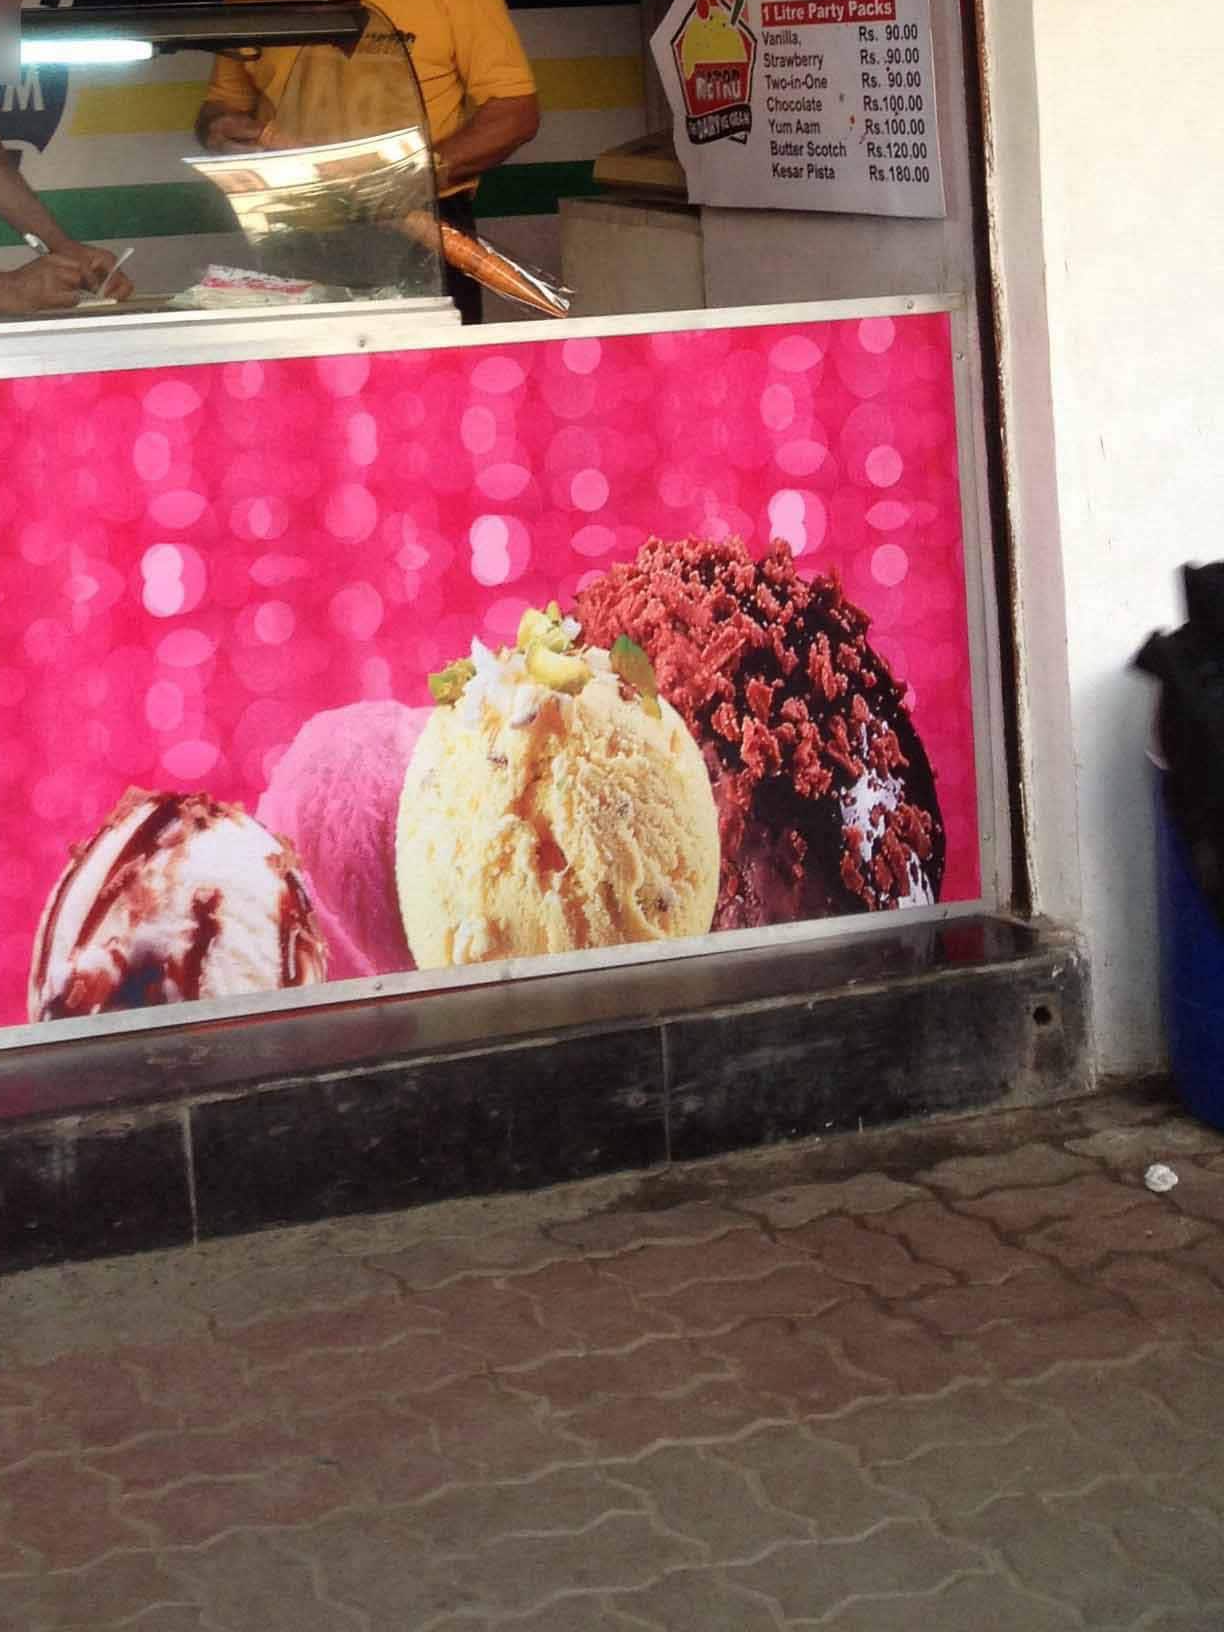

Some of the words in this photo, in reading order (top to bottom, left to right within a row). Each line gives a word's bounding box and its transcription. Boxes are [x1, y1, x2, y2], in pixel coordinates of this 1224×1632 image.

[762, 6, 770, 21] 1
[774, 5, 805, 21] Litre
[808, 3, 844, 22] Party
[848, 0, 892, 17] Packs
[858, 26, 878, 41] Rs.
[885, 24, 918, 40] 90.00
[763, 53, 824, 70] Strawberry
[860, 49, 879, 64] Rs.
[886, 48, 919, 64] 90.00
[765, 73, 828, 89] Two-in-One
[861, 72, 880, 88] Rs.
[888, 71, 921, 87] 90.00
[766, 96, 822, 112] Chocolate
[768, 118, 792, 134] Yum
[796, 118, 821, 134] Aam
[770, 140, 804, 156] Butter
[807, 140, 847, 157] Scotch
[772, 162, 804, 178] Kesar
[807, 163, 835, 179] Pista
